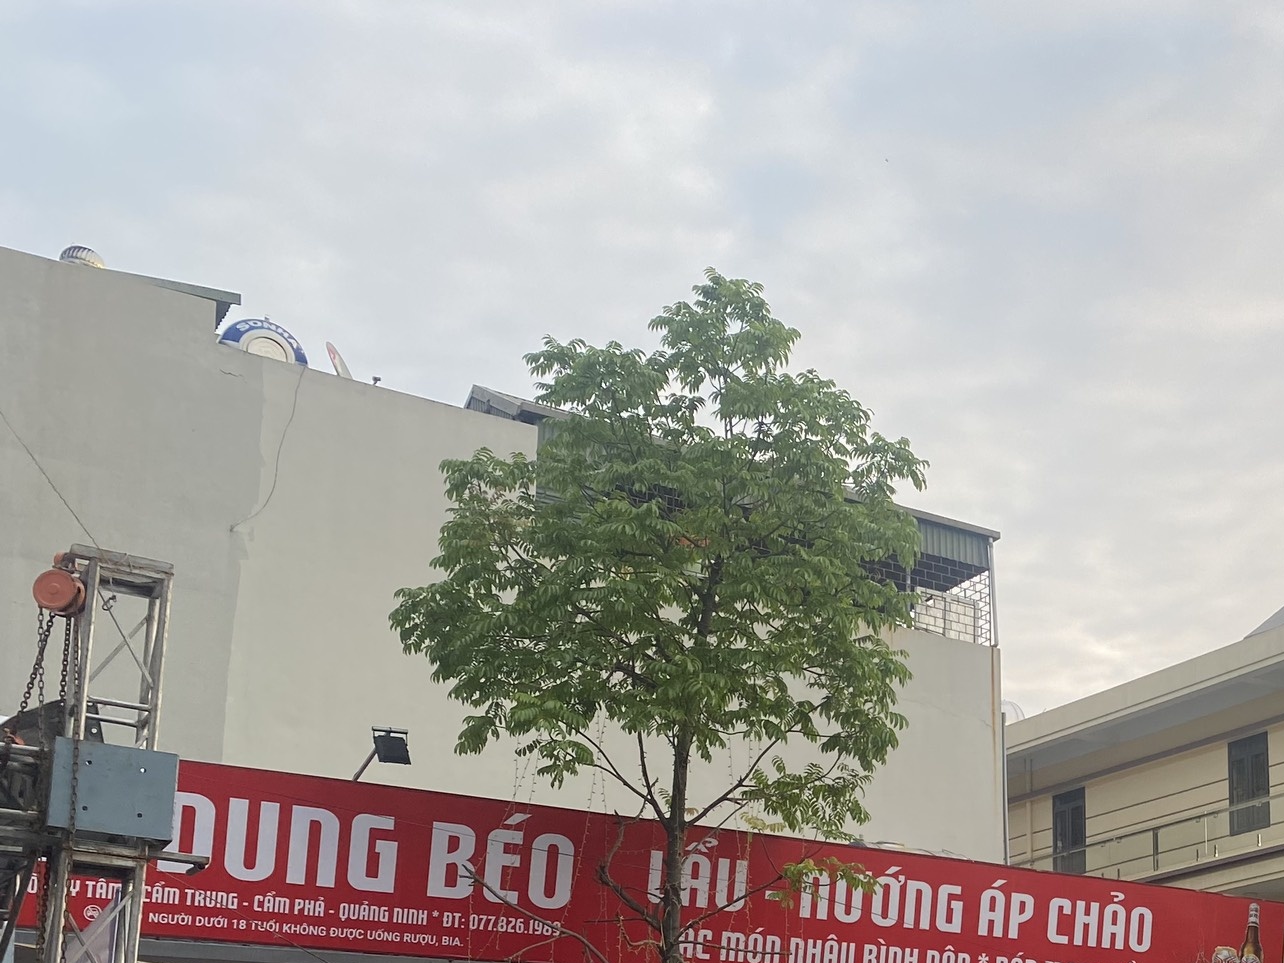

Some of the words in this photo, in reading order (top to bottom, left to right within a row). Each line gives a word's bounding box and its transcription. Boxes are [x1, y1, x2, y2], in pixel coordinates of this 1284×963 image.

[157, 791, 397, 893] DUNG
[426, 813, 575, 909] BÉO
[142, 881, 179, 905] CẨM
[185, 888, 238, 910] TRUNG
[253, 890, 289, 914] CẨM
[294, 896, 325, 917] PHẢ
[339, 900, 388, 923] QUẢNG
[393, 907, 428, 926] NINH
[442, 911, 465, 929] ĐT:
[148, 911, 192, 926] NGƯỜI
[195, 914, 228, 929] DƯỚI
[231, 918, 247, 930] 18
[250, 917, 280, 933] TUỔI
[282, 920, 327, 937] KHÔNG
[330, 927, 364, 941] ĐƯỢC
[367, 927, 401, 942] UỐNG
[403, 932, 439, 946] RƯỢU,
[441, 935, 464, 947] BIA.
[647, 838, 748, 912] LẨU
[799, 866, 963, 933] NƯỚNG
[978, 879, 1034, 940] ÁP
[1047, 891, 1153, 953] CHẢO
